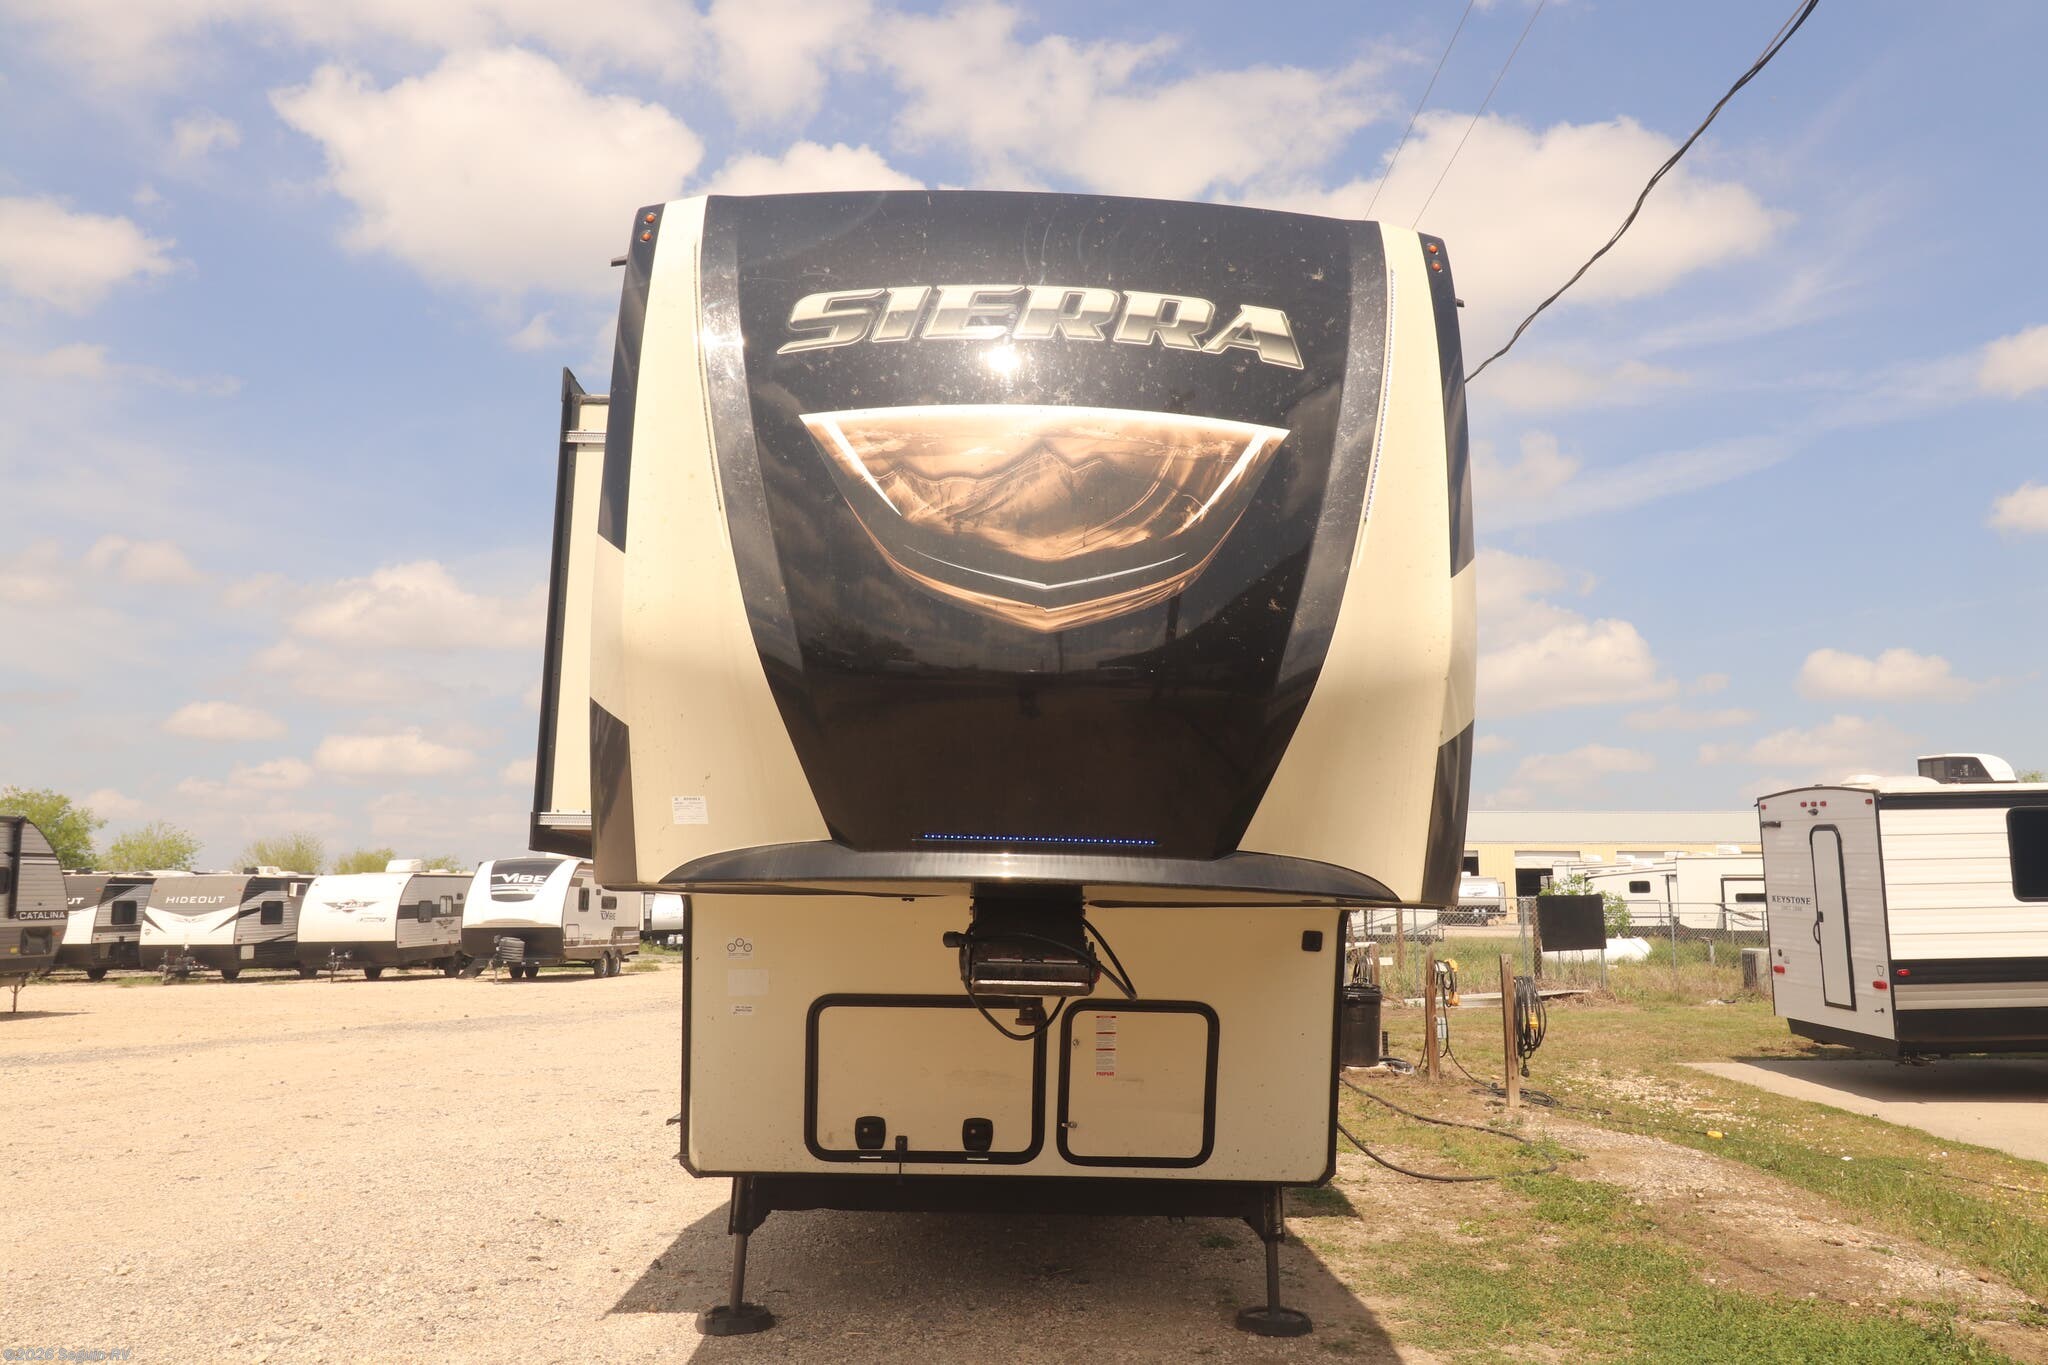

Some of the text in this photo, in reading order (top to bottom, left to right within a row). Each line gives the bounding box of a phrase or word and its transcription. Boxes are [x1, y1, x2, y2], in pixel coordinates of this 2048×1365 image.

[777, 284, 1304, 370] SIERRA
[492, 873, 547, 884] VIBE
[165, 896, 225, 904] HIDEOUT
[1772, 896, 1811, 904] KEYSTONE
[19, 911, 66, 920] CATALINA
